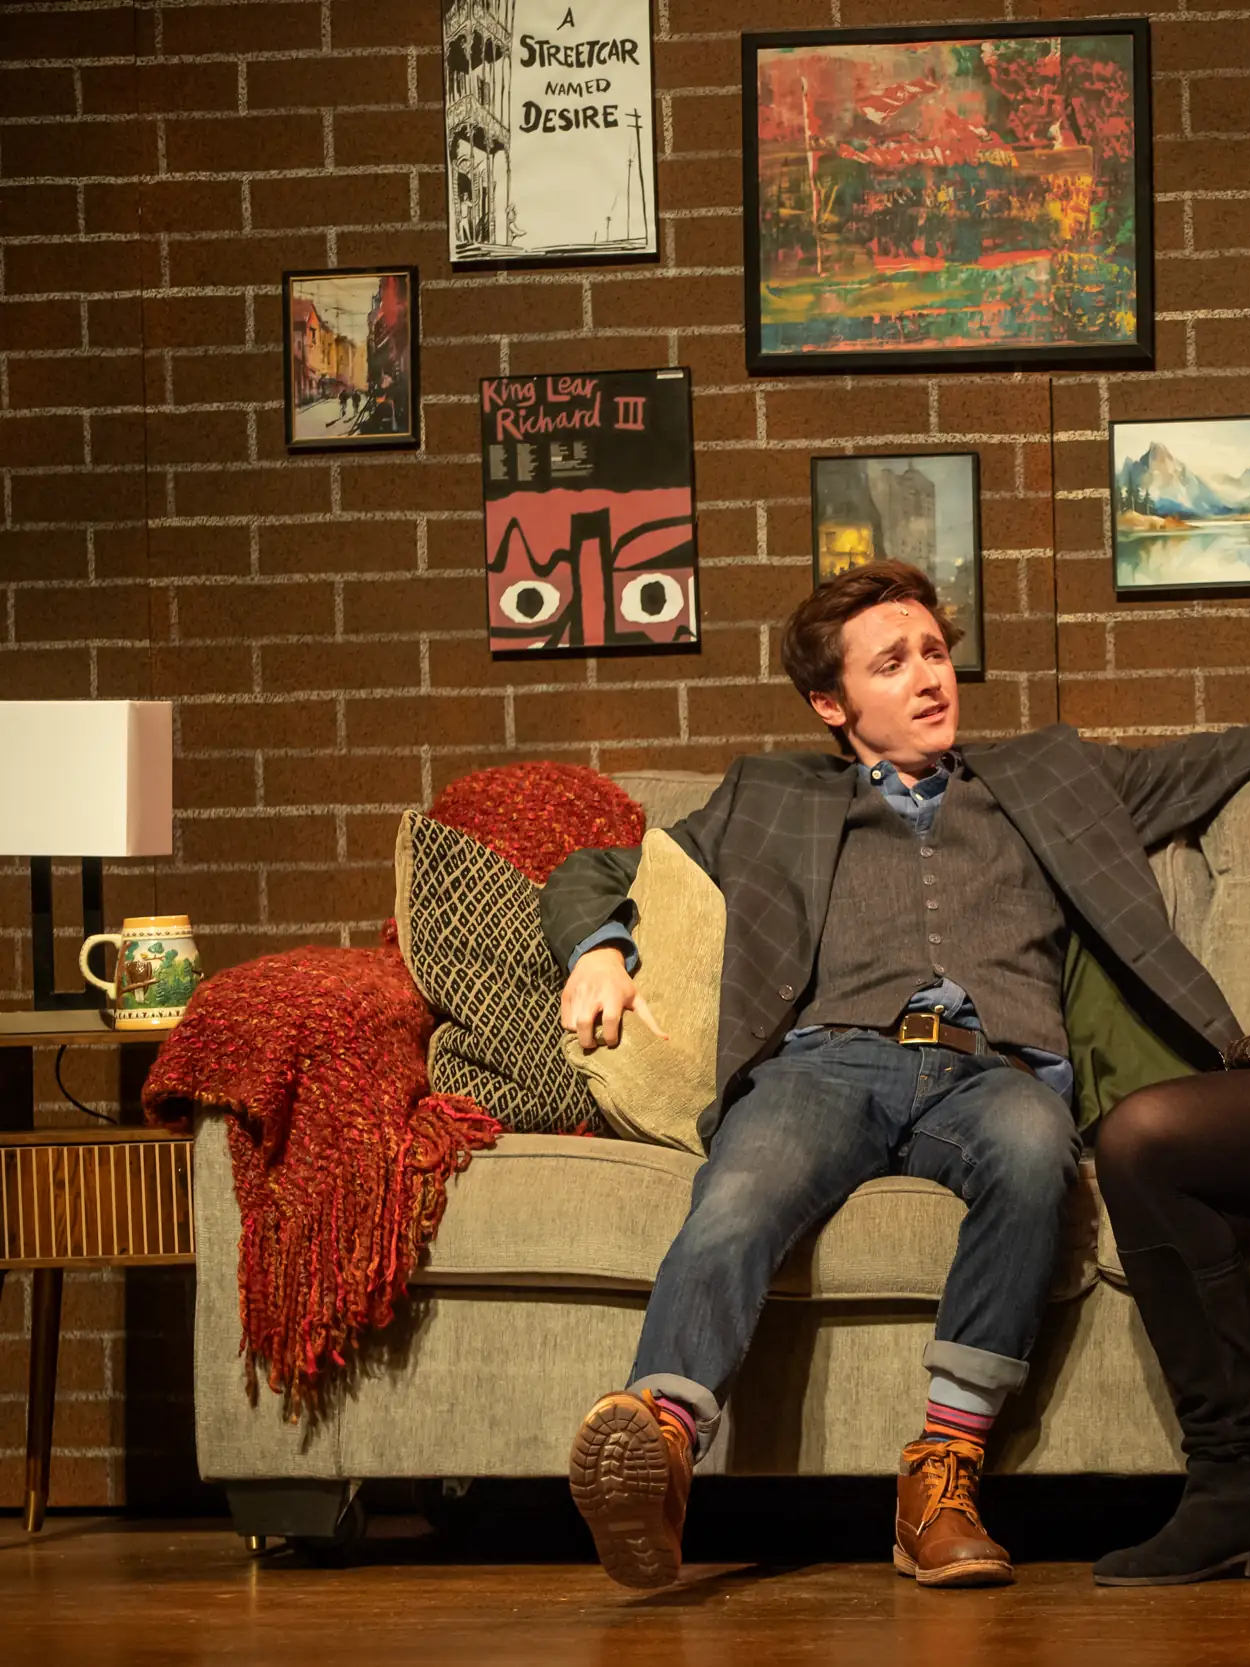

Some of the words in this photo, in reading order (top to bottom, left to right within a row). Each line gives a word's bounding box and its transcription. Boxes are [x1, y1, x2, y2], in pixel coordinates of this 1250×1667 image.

[556, 7, 575, 31] A
[519, 34, 640, 68] STREETCAR
[545, 78, 611, 98] NAMED
[519, 100, 618, 133] DESIRE
[482, 379, 536, 412] King
[547, 376, 599, 403] Lear
[496, 391, 601, 441] Richard
[613, 396, 647, 430] III
